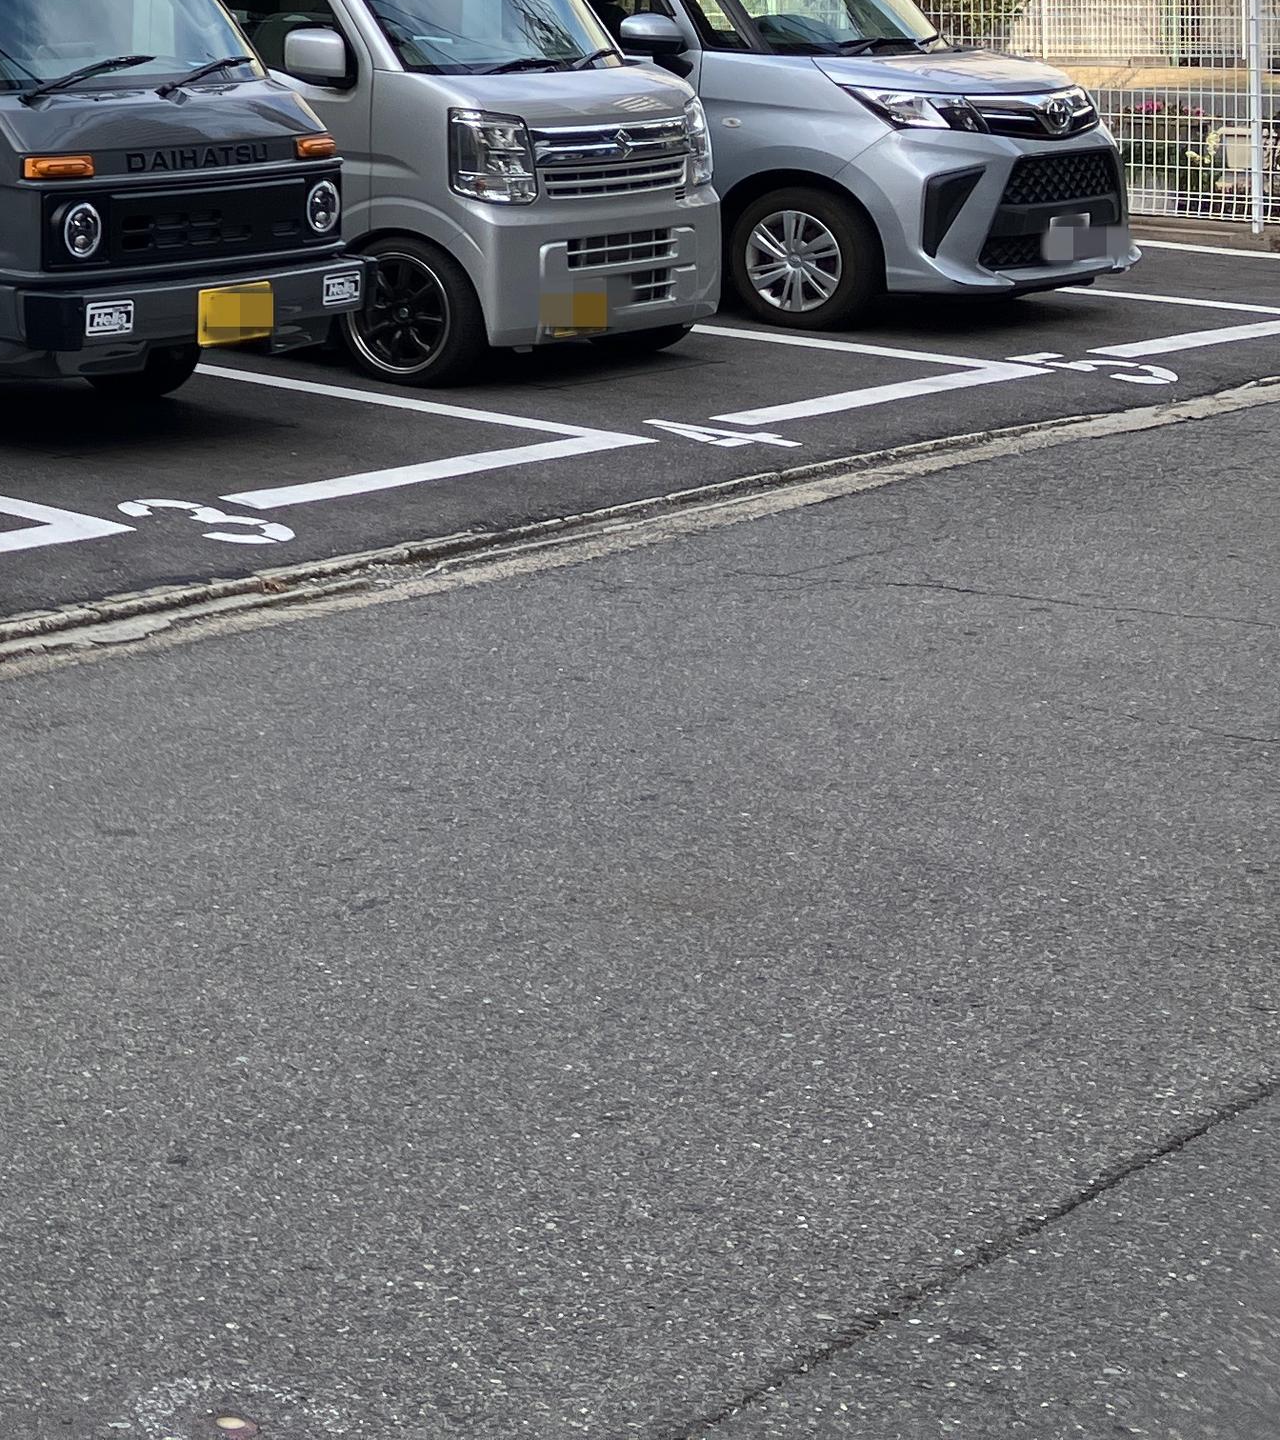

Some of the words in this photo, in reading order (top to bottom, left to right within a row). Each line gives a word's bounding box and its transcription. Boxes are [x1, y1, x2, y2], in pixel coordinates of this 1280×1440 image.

[126, 143, 268, 172] DAIHATSU
[1004, 351, 1179, 385] 5
[642, 418, 803, 448] 4
[117, 498, 296, 544] 3
